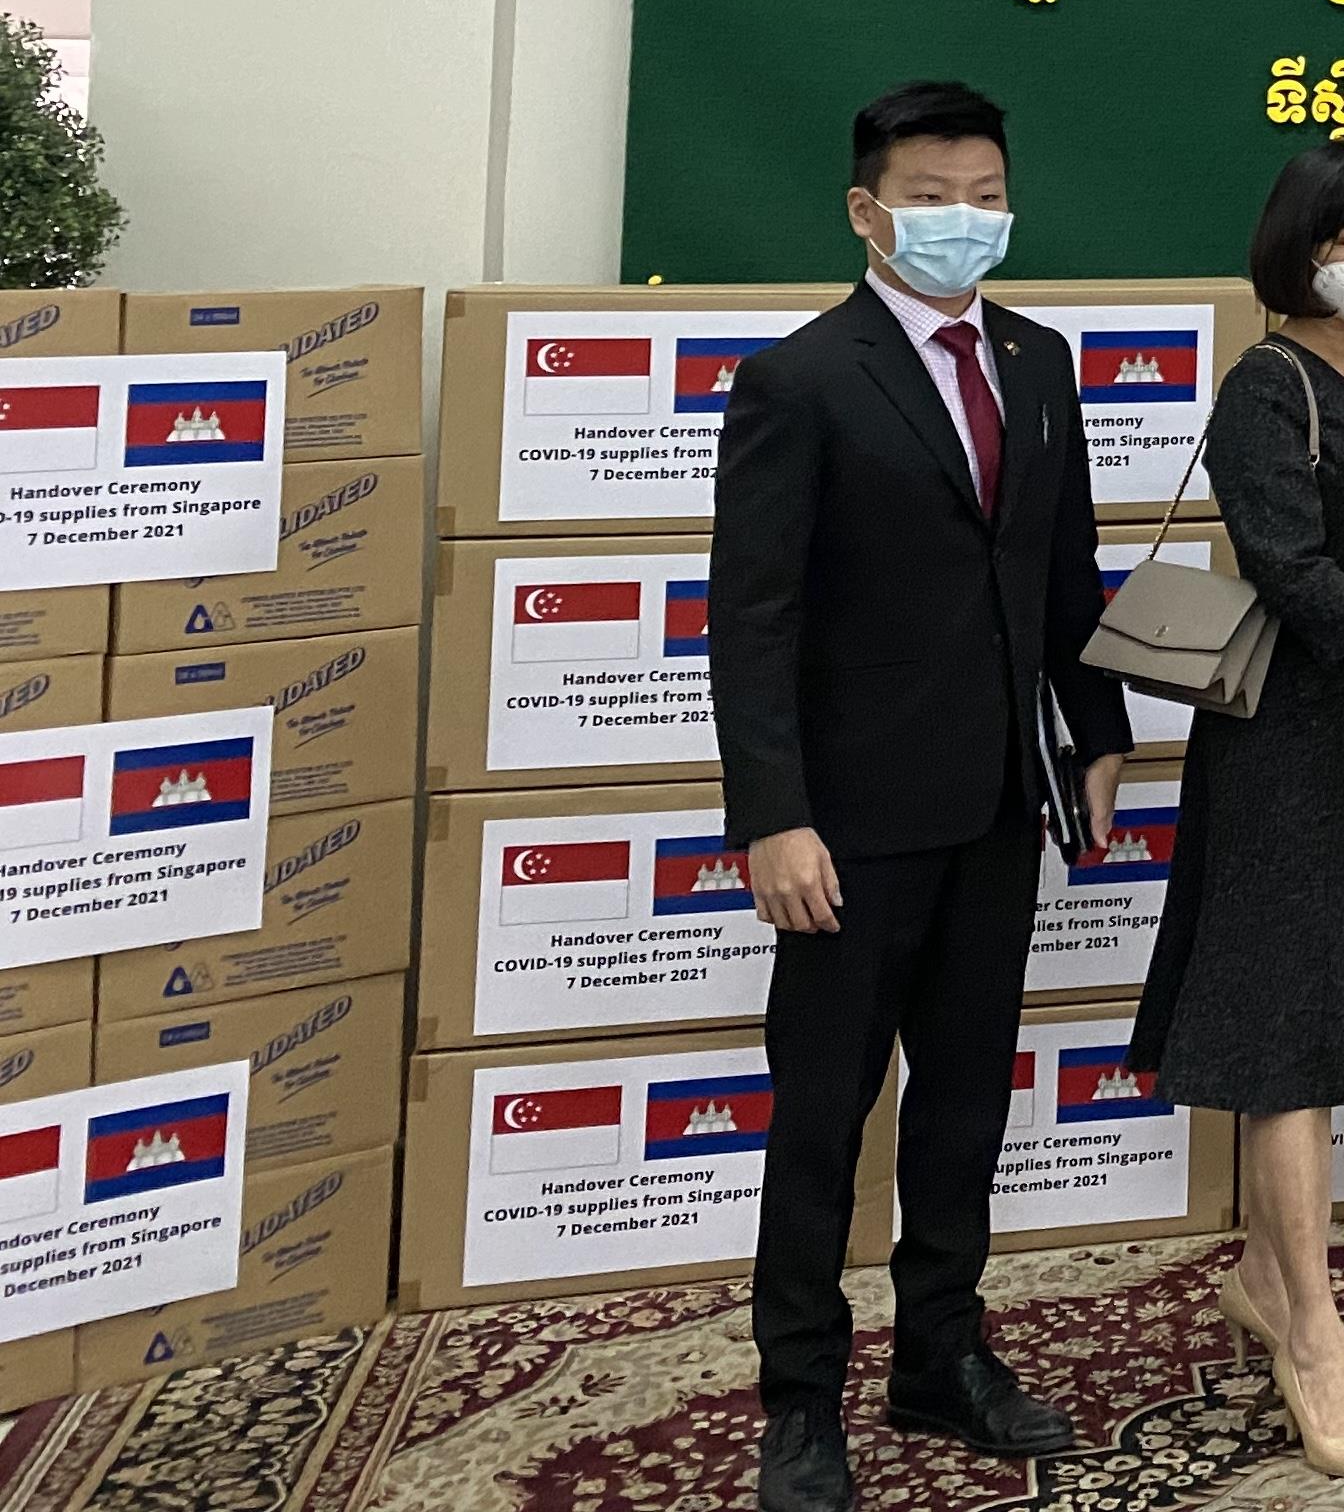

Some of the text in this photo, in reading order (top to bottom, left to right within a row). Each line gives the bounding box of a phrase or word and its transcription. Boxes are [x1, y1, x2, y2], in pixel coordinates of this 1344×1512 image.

[574, 426, 723, 440] Handover Ceremo
[1084, 417, 1144, 430] remony
[1119, 434, 1195, 450] Singapore
[518, 446, 712, 463] COVID-19 supplies from
[1095, 455, 1130, 467] 2021
[589, 467, 718, 481] 7 December 202
[10, 480, 201, 500] Handover Ceremony
[39, 505, 117, 525] supplies
[122, 503, 167, 517] from
[172, 499, 261, 516] Singapore
[27, 523, 184, 546] 7 December 2021
[563, 671, 711, 686] Handover Ceremo
[506, 690, 702, 709] COVID-19 supplies from
[578, 715, 588, 728] 7
[592, 711, 678, 727] December
[92, 843, 187, 865] Ceremony
[22, 877, 102, 899] supplies
[107, 871, 152, 887] from
[157, 858, 247, 880] Singapore
[10, 889, 168, 924] 7 December 2021
[1054, 896, 1133, 911] Ceremony
[1036, 914, 1159, 933] lies from Singap
[550, 926, 724, 948] Handover Ceremony
[1031, 936, 1118, 953] ember 2021
[494, 943, 776, 973] COVID-19 supplies from Singapore
[566, 967, 707, 990] 7 December 2021
[1003, 1133, 1122, 1153] over Ceremony
[996, 1149, 1173, 1176] upplies from Singapore
[541, 1170, 715, 1196] Handover Ceremony
[991, 1173, 1107, 1195] December 2021
[483, 1186, 761, 1223] COVID-19 supplies from Singapor
[0, 1205, 160, 1251] ndover Ceremony
[556, 1211, 698, 1238] 7 December 2021
[0, 1216, 222, 1275] supplies from Singapore
[4, 1253, 142, 1298] December 2021
